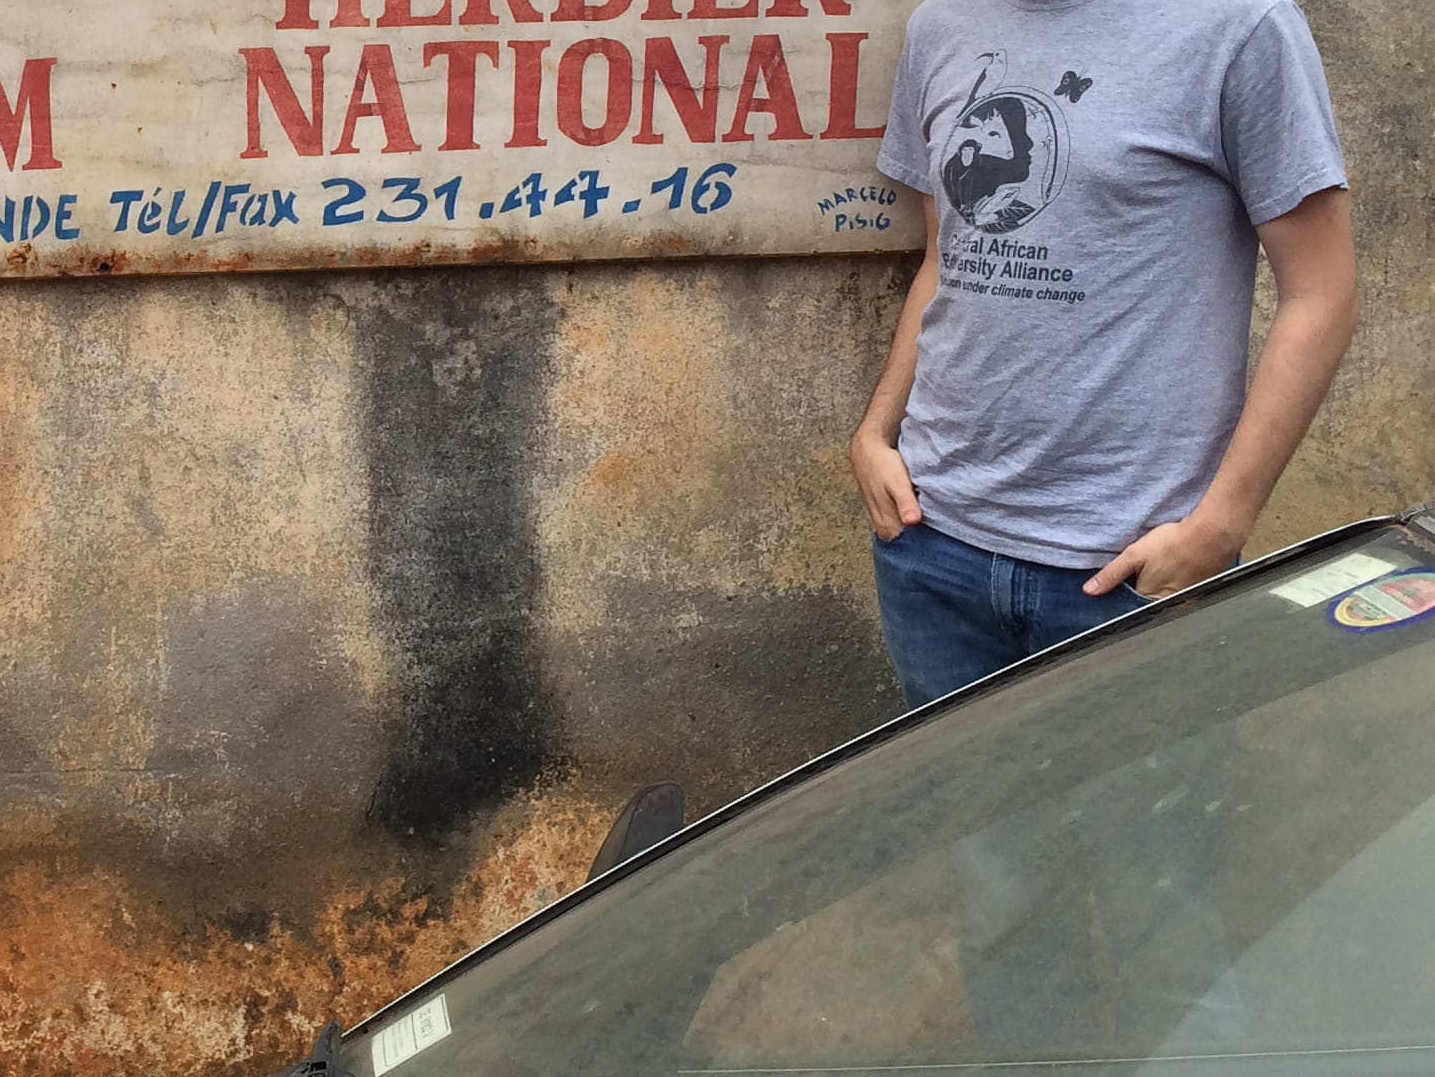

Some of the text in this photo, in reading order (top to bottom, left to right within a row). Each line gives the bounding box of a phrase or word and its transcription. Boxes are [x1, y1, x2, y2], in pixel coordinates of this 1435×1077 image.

[238, 32, 886, 159] NATIONAL
[109, 180, 299, 238] Tél/Fax
[987, 238, 1049, 260] African
[999, 260, 1074, 282] Alliance
[991, 284, 1034, 299] climate
[1036, 288, 1086, 304] change
